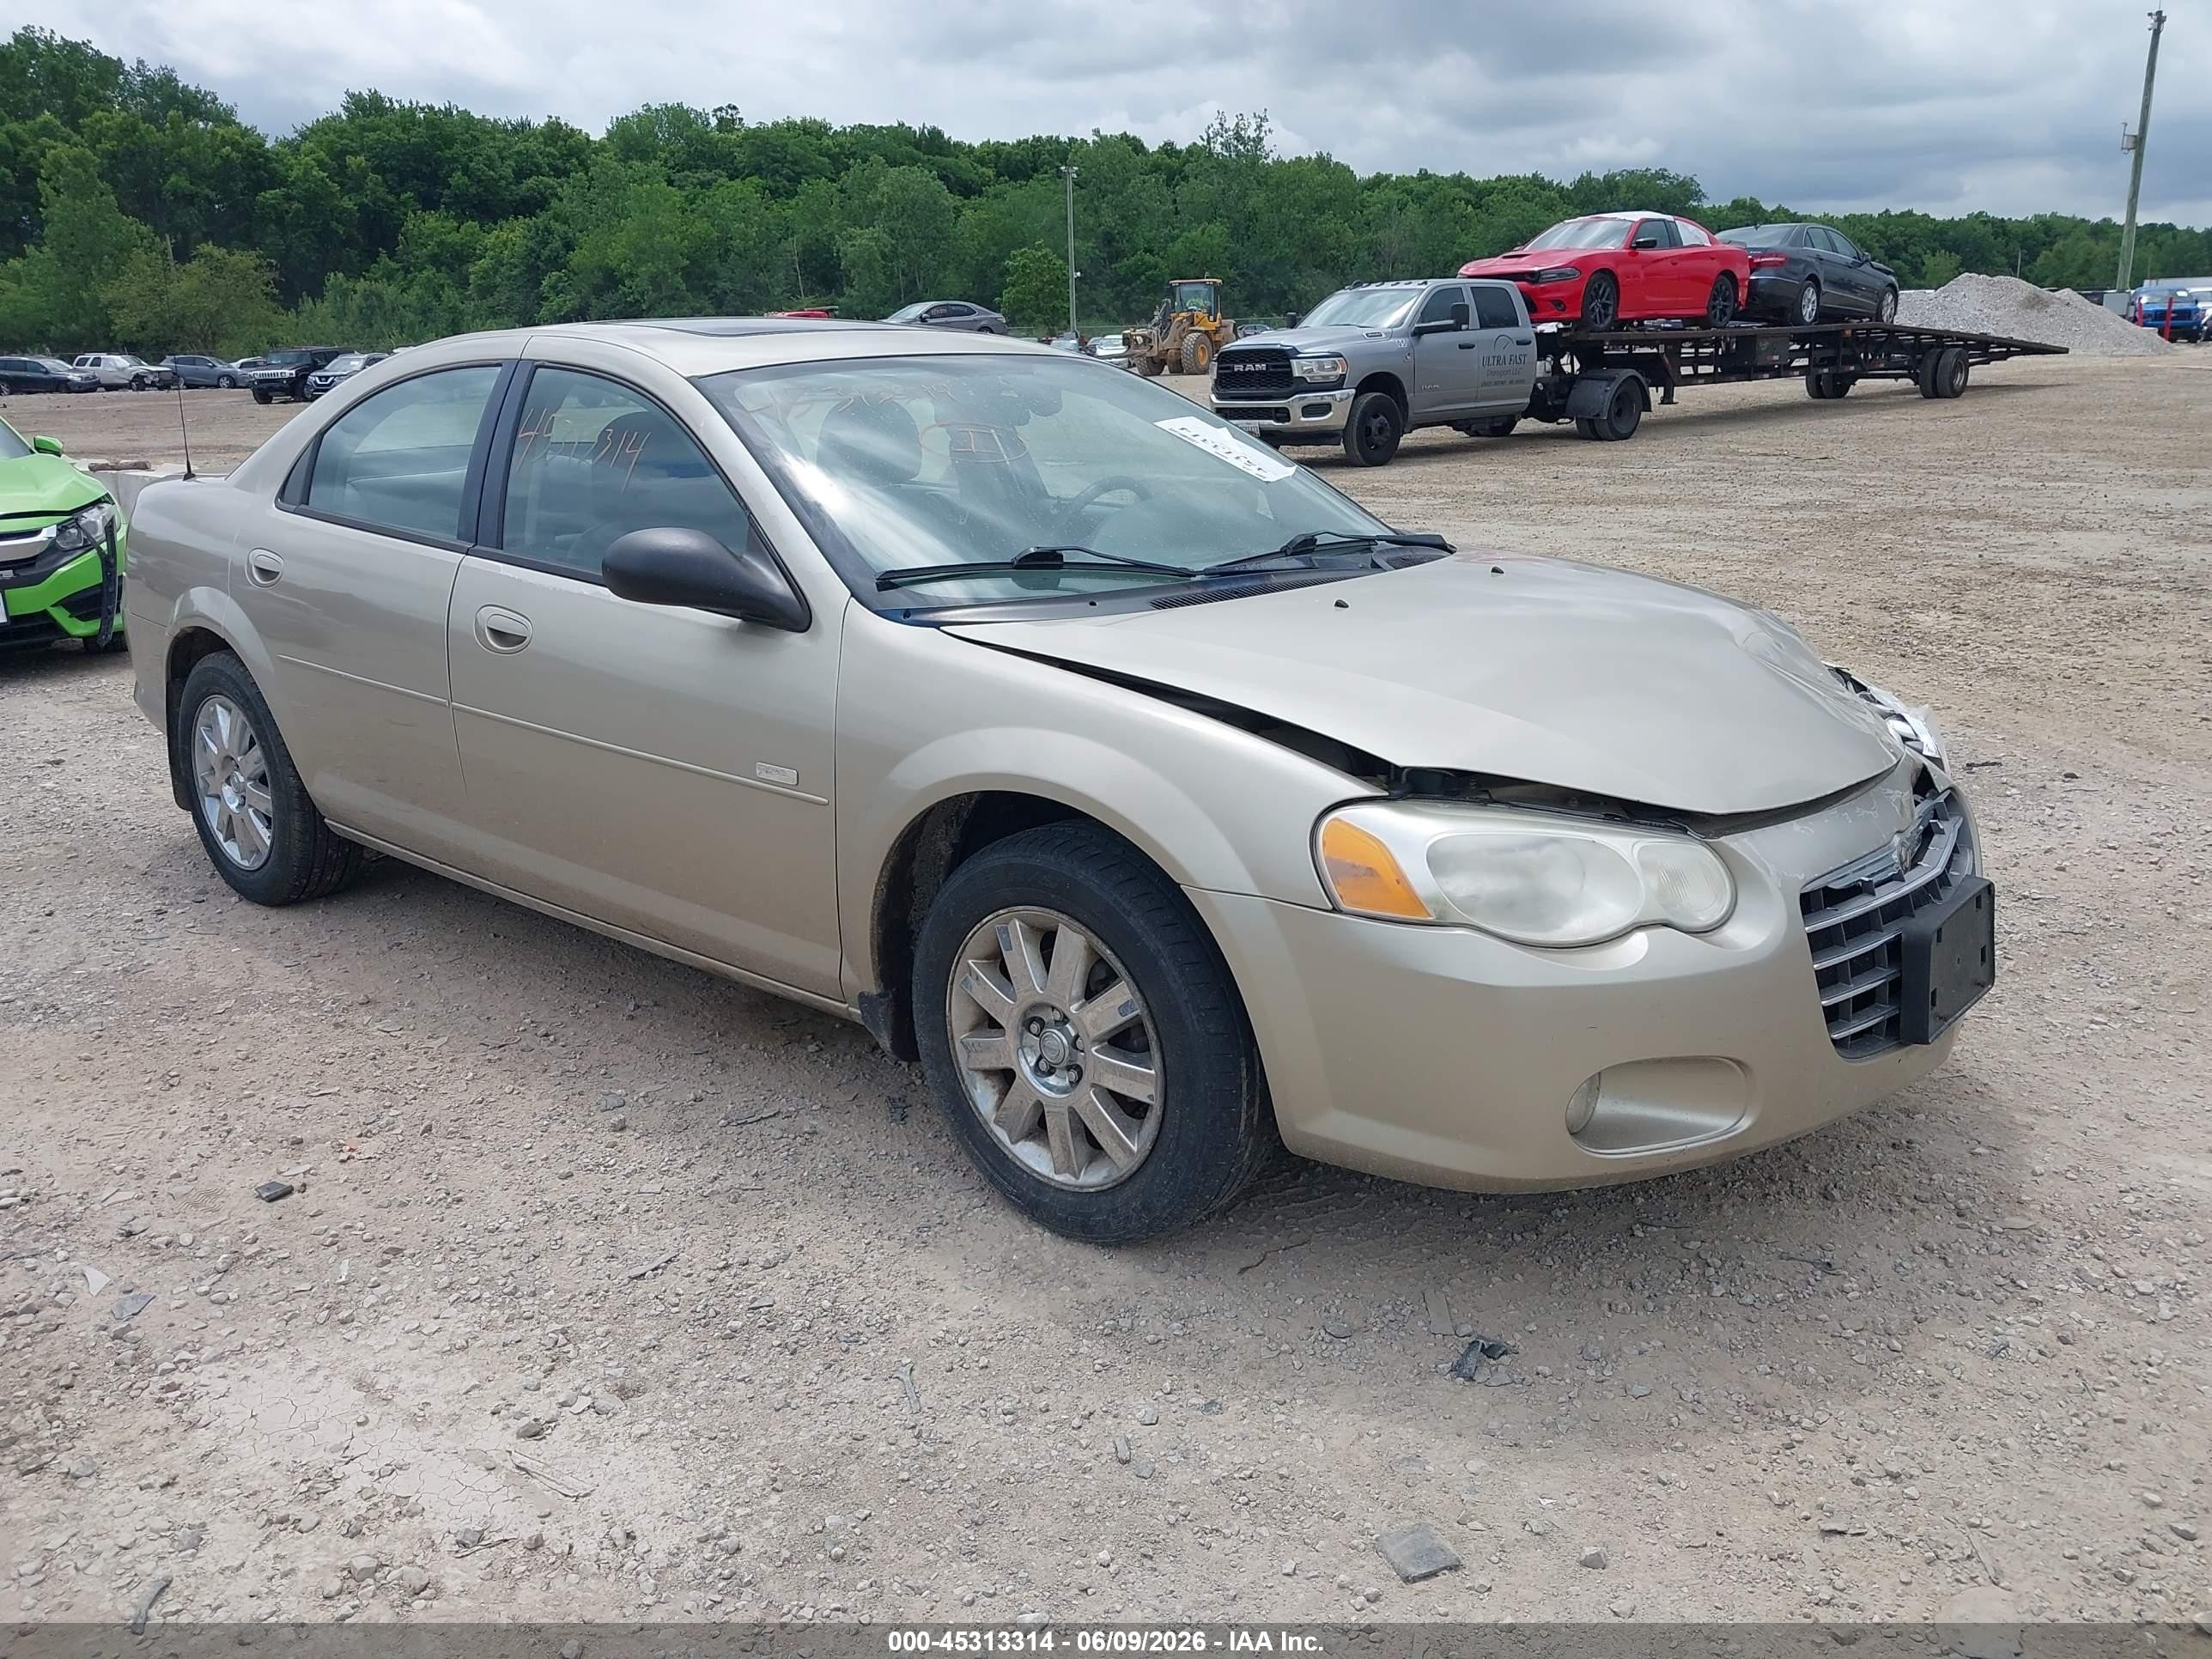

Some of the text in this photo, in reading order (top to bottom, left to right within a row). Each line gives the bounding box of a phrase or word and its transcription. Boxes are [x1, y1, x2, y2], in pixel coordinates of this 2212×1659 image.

[1481, 353, 1528, 367] ULTRA FAST
[1233, 363, 1267, 372] RAM
